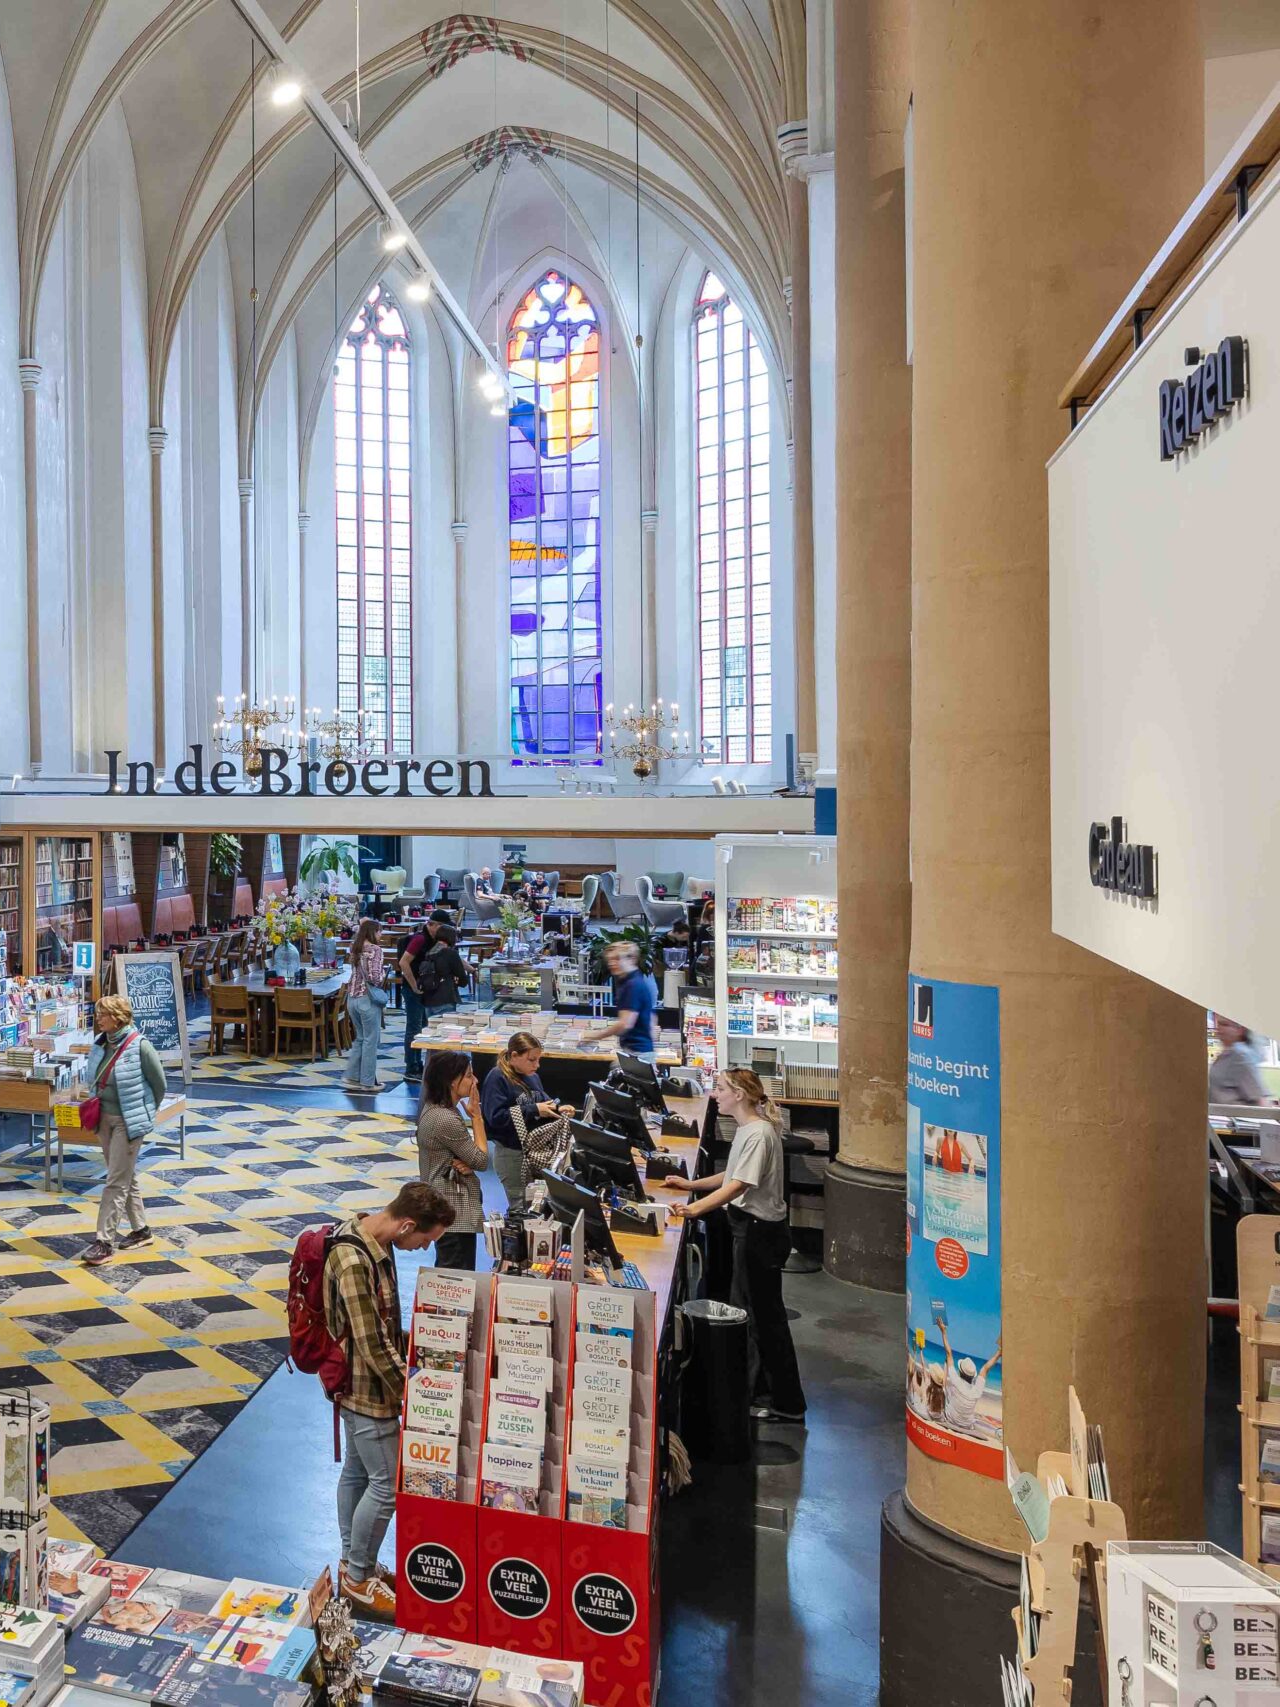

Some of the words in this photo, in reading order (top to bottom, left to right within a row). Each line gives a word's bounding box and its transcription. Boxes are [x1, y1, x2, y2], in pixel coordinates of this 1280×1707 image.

[1158, 335, 1245, 462] Reizen
[103, 749, 157, 796] In
[174, 744, 247, 796] de
[254, 747, 497, 797] Broeren
[912, 1025, 933, 1038] LIBRIS
[935, 1055, 990, 1080] begint
[914, 1072, 961, 1098] boeken
[925, 1205, 973, 1232] Vermeer
[933, 1199, 985, 1226] Suzanne
[927, 1222, 956, 1238] FLAMINGO
[957, 1229, 980, 1243] BEACH
[427, 1281, 472, 1295] OLYMPISCHE
[436, 1289, 462, 1299] SPELEN
[587, 1301, 624, 1314] GROTE
[591, 1310, 620, 1320] BOSATLAS
[500, 1346, 540, 1356] PUZZELBOEK
[515, 1341, 543, 1350] MUSEUM
[585, 1343, 622, 1357] GROTE
[588, 1353, 618, 1362] BOSATLAS
[505, 1361, 521, 1370] Van
[522, 1363, 546, 1374] Gogh
[508, 1370, 543, 1381] Museum
[584, 1375, 621, 1388] GROTE
[415, 1388, 453, 1398] PUZZELBOEK
[587, 1385, 617, 1394] BOSATLAS
[412, 1404, 455, 1419] VOETBAL
[582, 1400, 620, 1414] GROTE
[510, 1414, 532, 1424] ZEVEN
[586, 1410, 616, 1420] BOSATLAS
[497, 1421, 534, 1434] ZUSSEN
[925, 1430, 952, 1448] boeken
[408, 1442, 451, 1465] QUIZ
[584, 1442, 615, 1452] BOSATLAS
[487, 1454, 533, 1470] happinez
[575, 1465, 620, 1480] Nederland
[580, 1475, 589, 1483] in
[590, 1476, 613, 1488] kaart
[417, 1553, 453, 1569] EXTRA
[421, 1564, 449, 1579] VEEL
[500, 1568, 537, 1585] EXTRA
[411, 1574, 459, 1589] PUZZELPLEZIER
[504, 1580, 533, 1595] VEEL
[494, 1590, 544, 1605] PUZZELPLEZIER
[584, 1584, 623, 1600] EXTRA
[589, 1596, 619, 1611] VEEL
[1148, 1600, 1165, 1622] RE
[578, 1605, 631, 1621] PUZZELPLEZIER
[1233, 1618, 1258, 1633] BE
[93, 1633, 135, 1648] DESIGNER
[136, 1637, 154, 1647] THE
[1150, 1623, 1167, 1646] RE
[1234, 1642, 1258, 1657] BE
[1151, 1647, 1168, 1670] RE
[1235, 1667, 1260, 1681] BE
